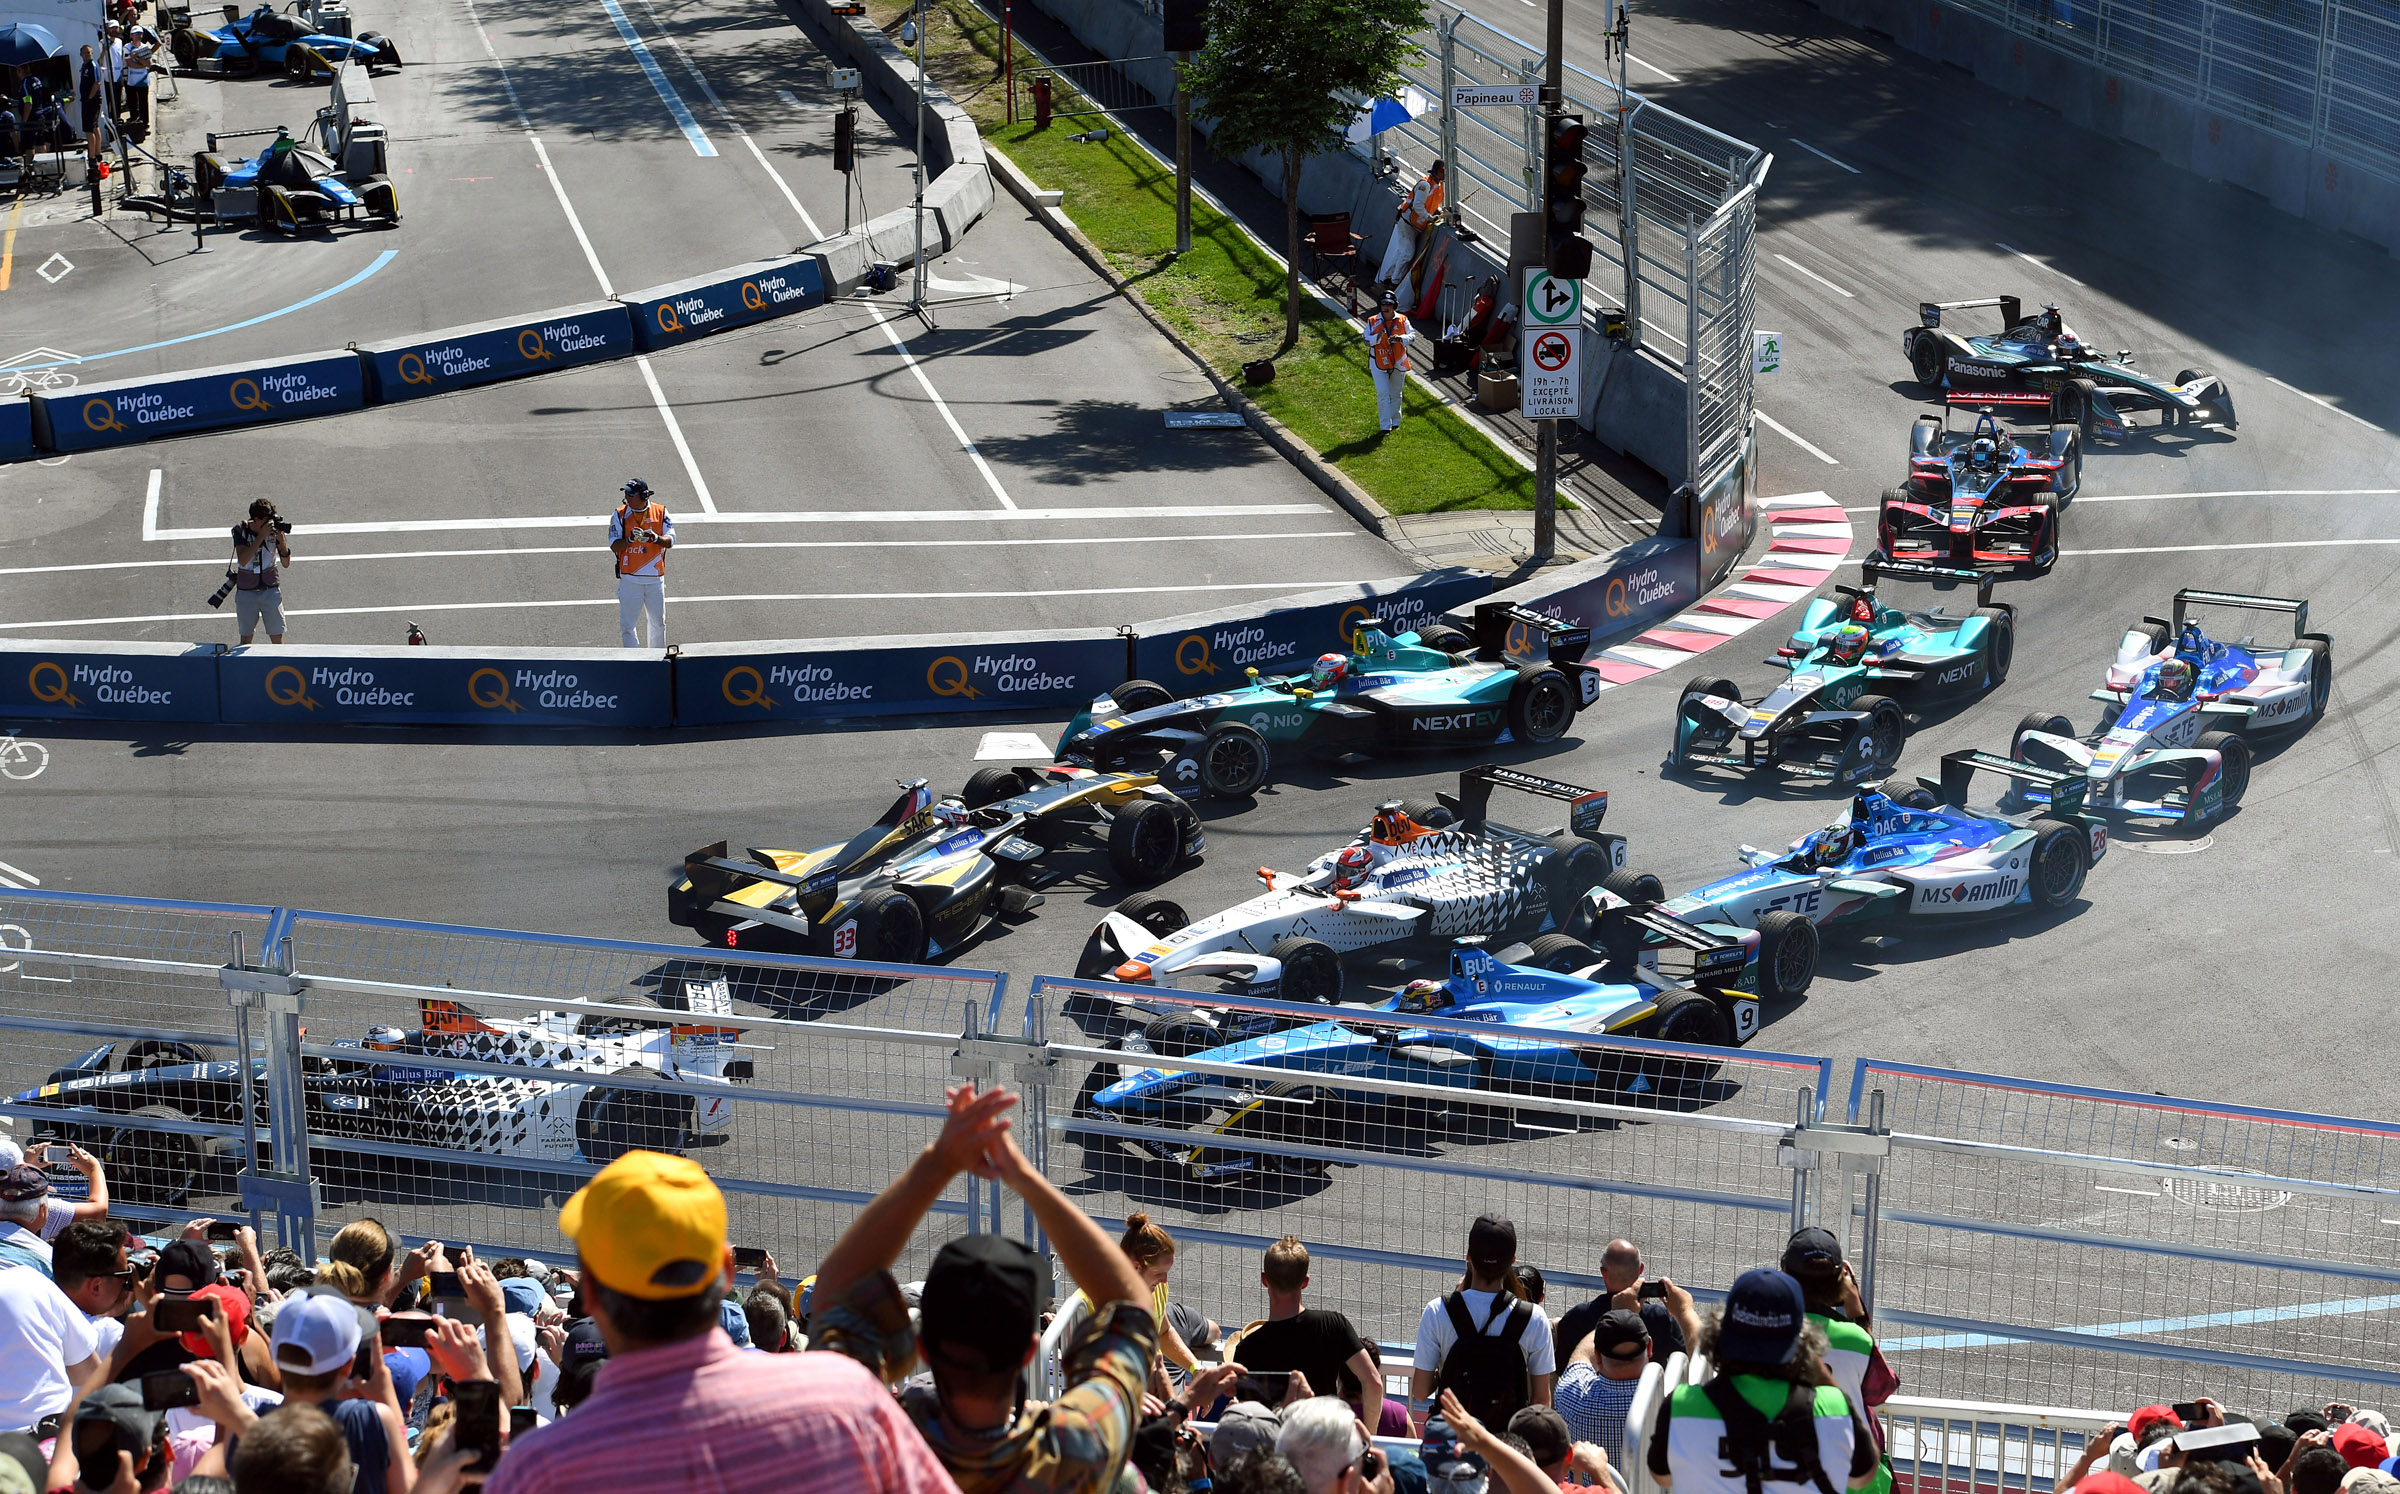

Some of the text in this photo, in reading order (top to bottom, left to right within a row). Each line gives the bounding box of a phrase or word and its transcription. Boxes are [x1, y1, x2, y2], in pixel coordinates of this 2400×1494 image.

[1456, 93, 1514, 106] Papineau
[758, 276, 786, 295] Hydro
[772, 286, 806, 303] Québec
[676, 297, 704, 316] Hydro
[690, 307, 725, 325] Québec
[2037, 316, 2049, 328] CAR
[543, 323, 581, 342] Hydro
[561, 334, 607, 352] Québec
[425, 346, 464, 366] Hydro
[443, 357, 491, 377] Québec
[1948, 357, 2007, 379] Panasonic
[262, 373, 307, 393] Hydro
[1533, 377, 1548, 386] 19h
[1559, 376, 1569, 386] 7h
[2076, 371, 2115, 385] JAGUAR
[282, 385, 337, 403] Québec
[1532, 386, 1569, 396] EXCEPTÉ
[117, 393, 162, 412] Hydro
[1528, 396, 1574, 406] LIVRAISON
[137, 405, 194, 425] Québec
[1534, 407, 1567, 416] LOCALE
[1714, 491, 1731, 521] Hydro
[1720, 504, 1740, 538] Québec
[1627, 567, 1658, 592] Hydro
[1638, 580, 1676, 606] Québec
[1394, 611, 1444, 634] Québe
[1213, 626, 1265, 650] Hydro
[1366, 632, 1388, 648] PIQ
[1232, 641, 1296, 665] Québec
[769, 662, 834, 686] Hydro
[974, 654, 1036, 677] Hydro
[1937, 654, 1985, 685] NEXTEV
[73, 665, 133, 687] Hydro
[312, 666, 375, 688] Hydro
[515, 669, 579, 691] Hydro
[998, 671, 1076, 692] Québec
[1357, 678, 1377, 689] Julius
[1379, 676, 1392, 687] Bär
[96, 684, 172, 706] Québec
[793, 678, 874, 702] Québec
[1585, 677, 1596, 695] 3
[1848, 684, 1864, 699] NIO
[336, 686, 415, 707] Québec
[539, 689, 619, 711] Québec
[2257, 702, 2278, 718] MS
[1273, 713, 1303, 728] NIO
[1412, 708, 1502, 732] NEXTEV
[1552, 782, 1593, 796] FUTUR
[902, 809, 928, 836] SAR
[1389, 818, 1412, 836] DUV
[1874, 816, 1897, 837] DAC
[948, 832, 980, 851] Julius Bär
[2092, 829, 2107, 853] 28
[1615, 845, 1624, 867] 6
[1873, 847, 1905, 863] Julius Bär
[1393, 869, 1425, 885] Julius Bär
[1794, 889, 1822, 913] TE
[1921, 887, 1952, 904] MS
[1525, 900, 1550, 911] FARADAY
[1527, 907, 1548, 916] FUTURE
[834, 927, 856, 953] 33
[1465, 956, 1496, 977] BUE
[1694, 965, 1743, 981] RICHARD MILLE
[1504, 982, 1547, 992] RENAULT
[422, 1008, 463, 1026] DAM
[1482, 1010, 1498, 1022] Bär
[1741, 1007, 1754, 1031] 9
[390, 1068, 444, 1081] Julius Bär
[1135, 1080, 1179, 1099] RICHARD
